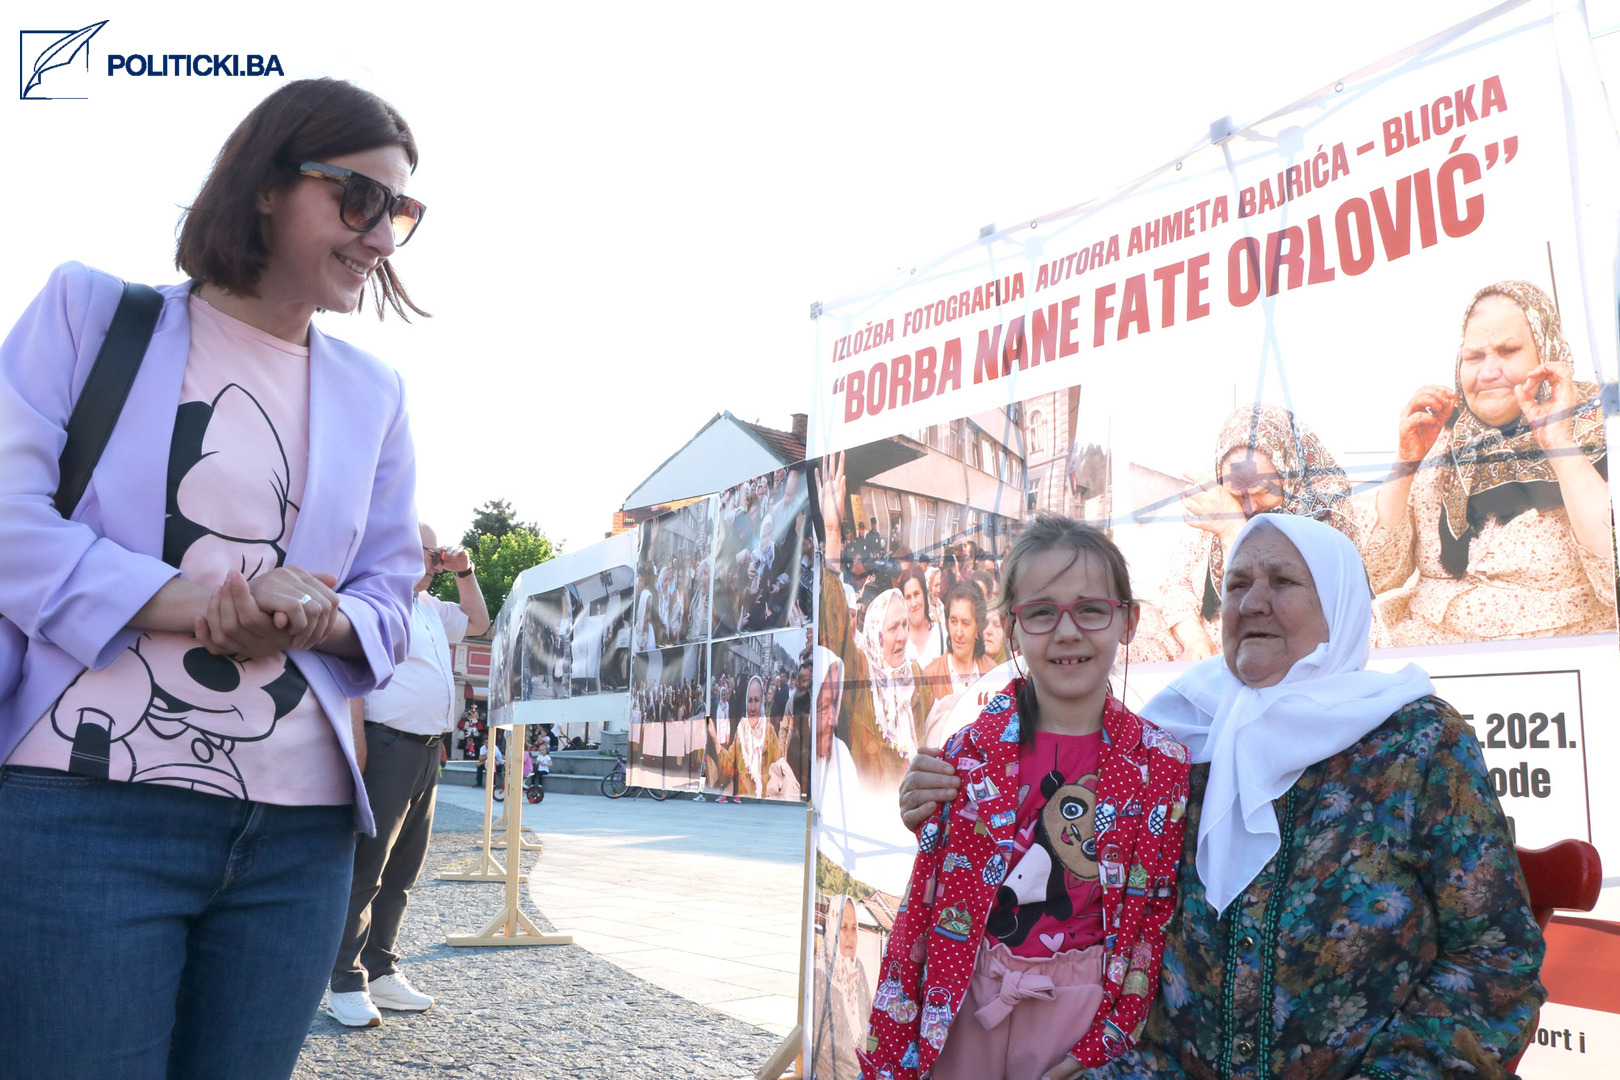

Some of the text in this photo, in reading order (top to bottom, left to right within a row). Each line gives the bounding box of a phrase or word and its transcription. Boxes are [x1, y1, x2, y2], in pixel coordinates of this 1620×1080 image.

[832, 318, 895, 363] IZLOŽBA
[902, 271, 1025, 338] FOTOGRAFIJA
[1035, 233, 1120, 293] AUTORA
[1126, 194, 1229, 258] AHMETA
[1237, 141, 1350, 219] BAJRIĆA
[1382, 74, 1508, 157] BLICKA
[973, 294, 1081, 385] NANE
[1093, 251, 1210, 348] FATE
[1531, 1028, 1586, 1053] ort i
